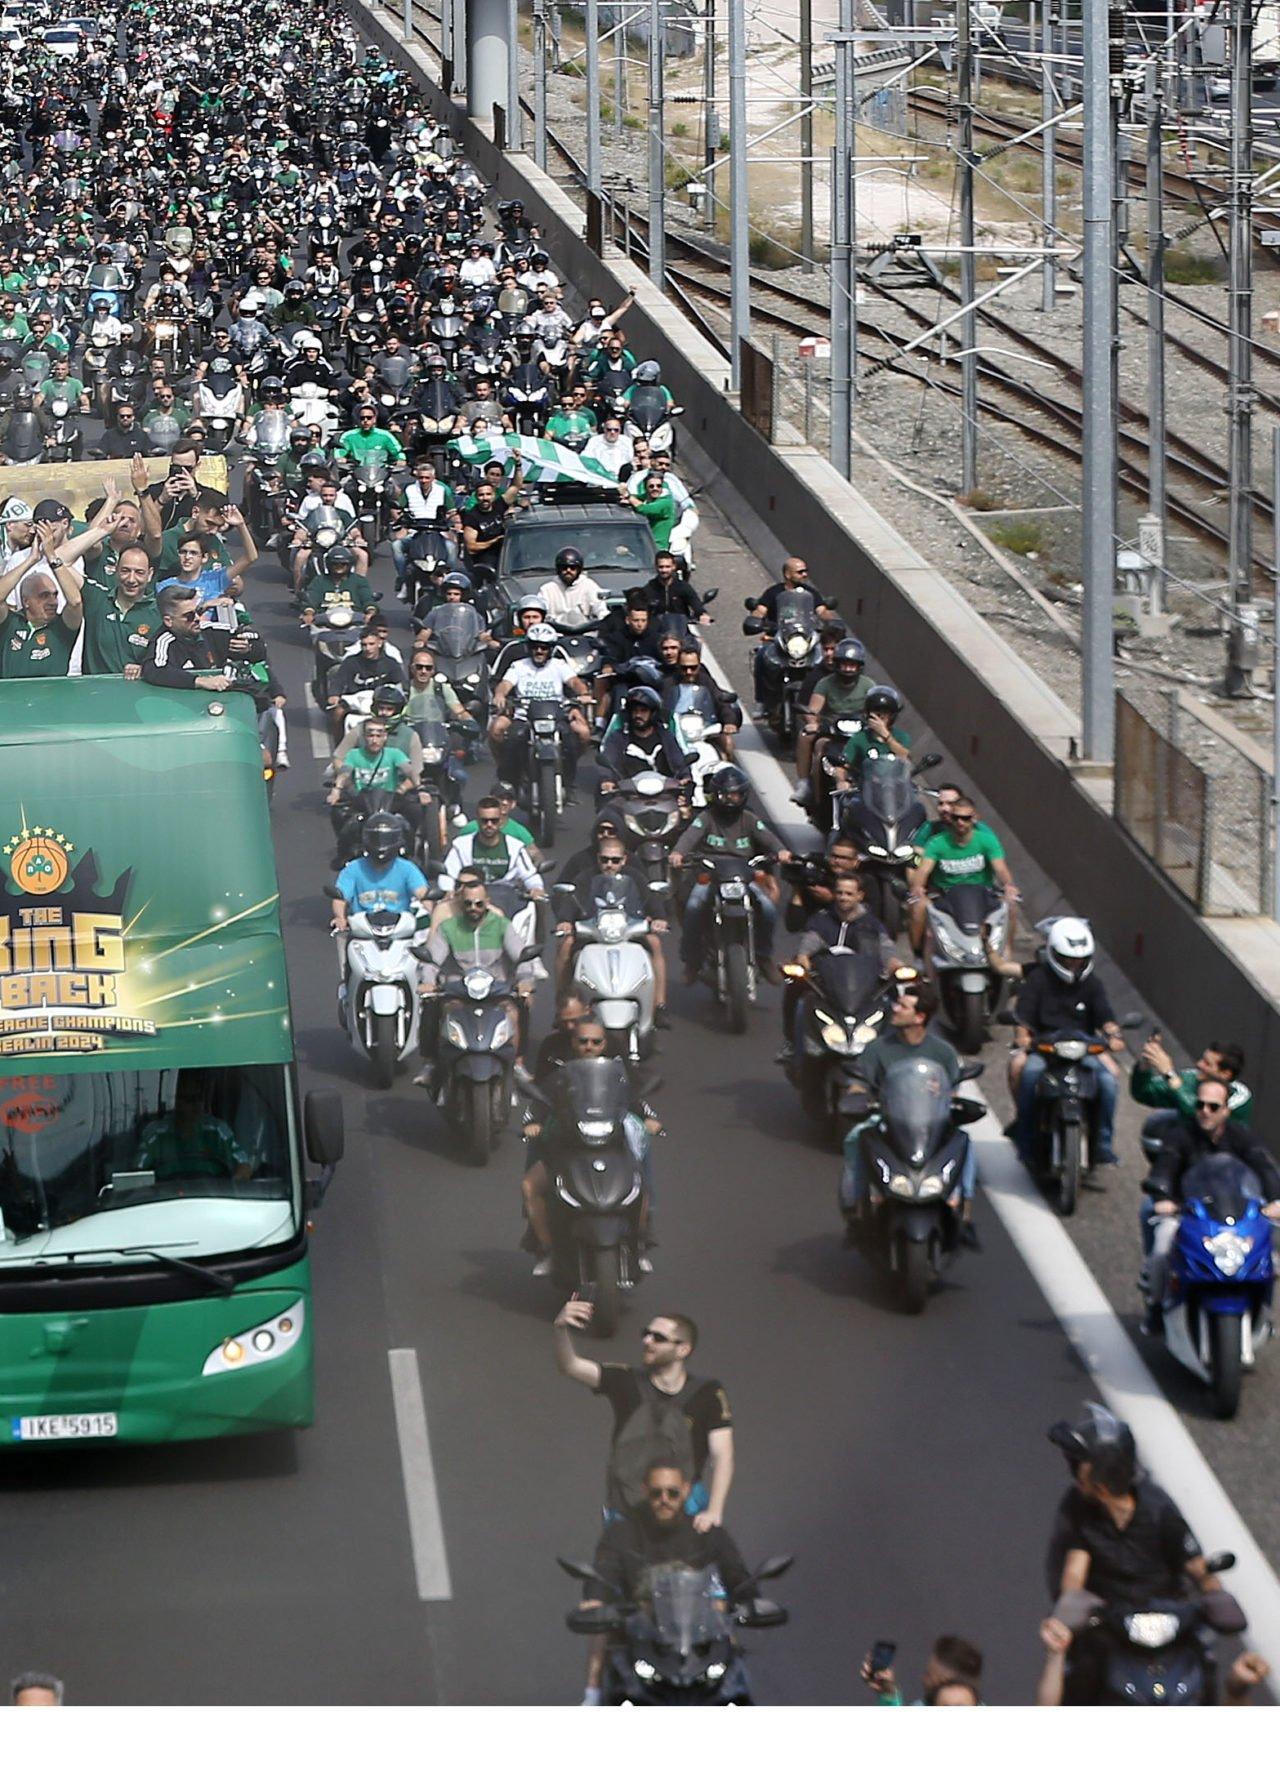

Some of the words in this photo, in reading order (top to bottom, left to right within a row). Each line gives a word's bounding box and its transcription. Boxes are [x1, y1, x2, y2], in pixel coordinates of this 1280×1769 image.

[18, 906, 63, 926] THE
[0, 973, 117, 1010] BACK
[51, 1014, 157, 1037] CHAMPIONS
[55, 1034, 105, 1051] 2024
